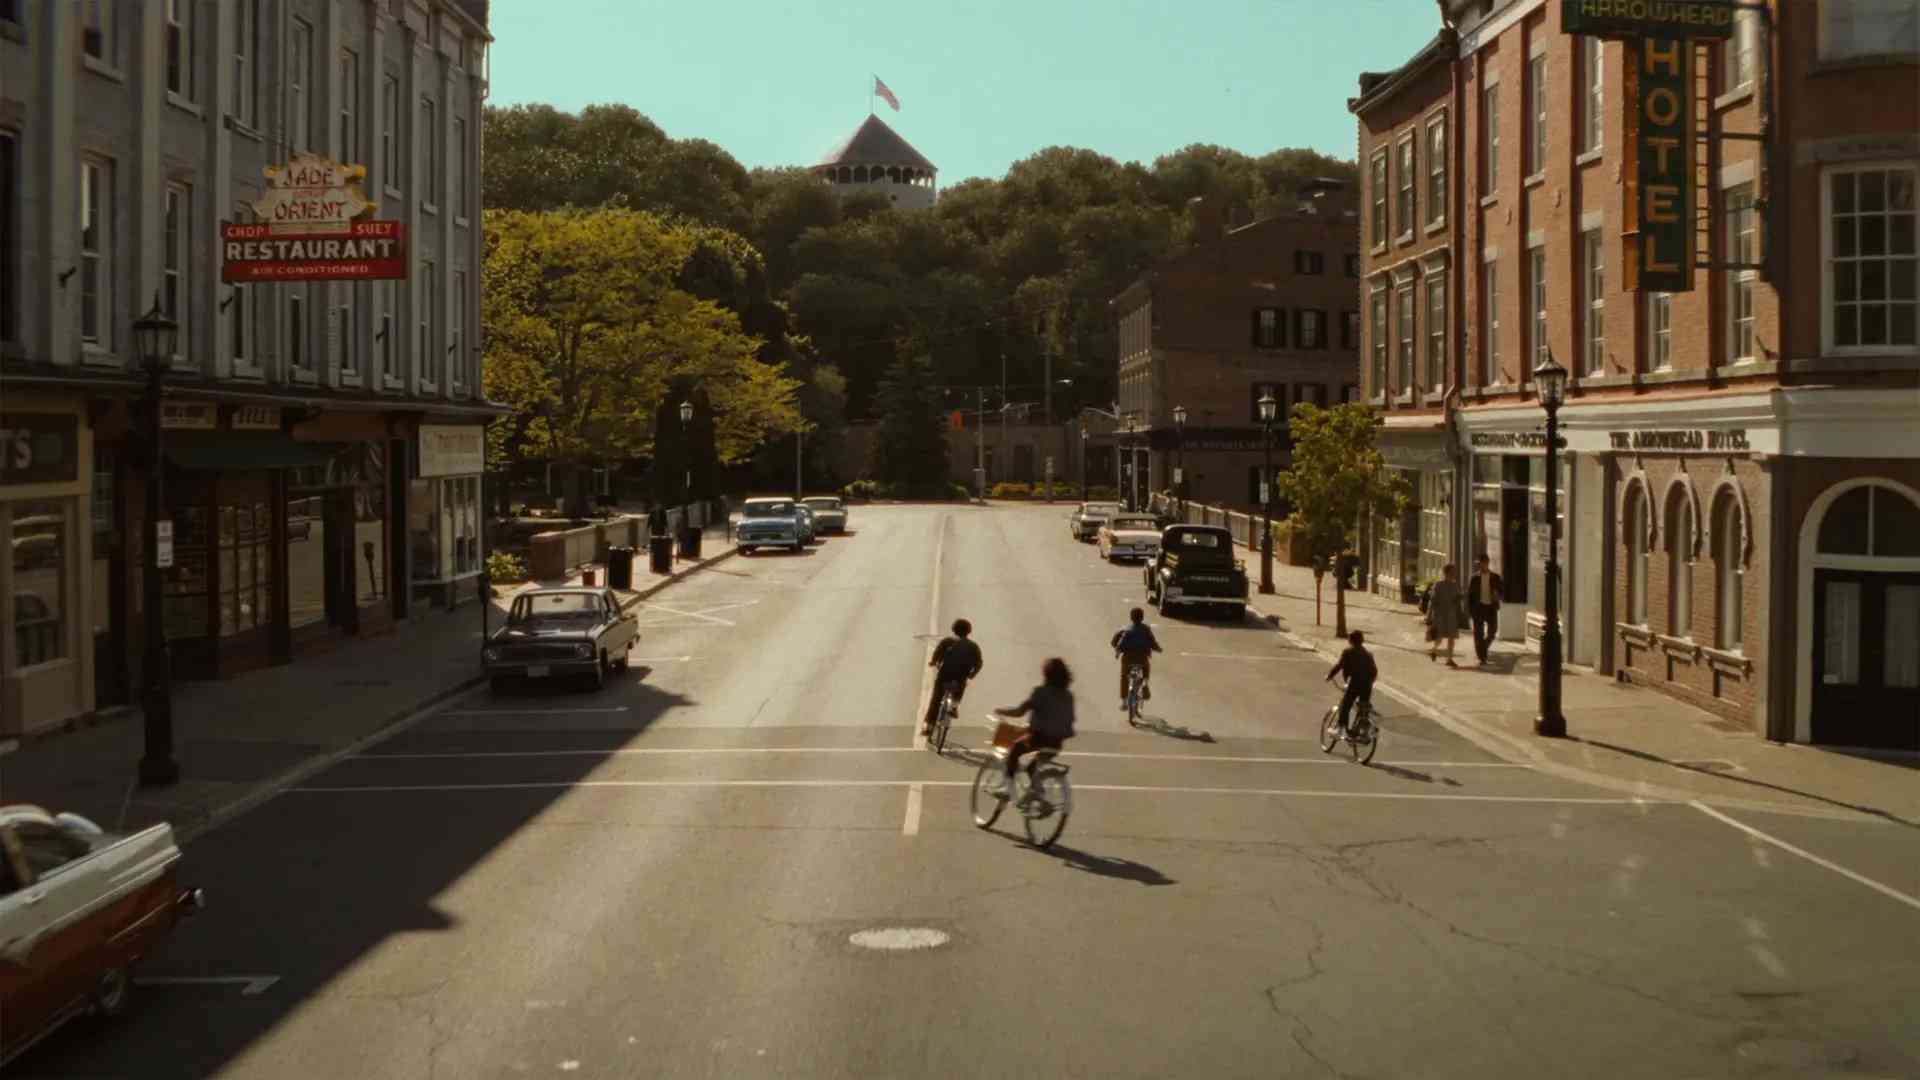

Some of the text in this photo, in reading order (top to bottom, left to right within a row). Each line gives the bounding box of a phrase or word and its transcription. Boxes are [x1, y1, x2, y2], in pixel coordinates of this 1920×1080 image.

[1581, 0, 1730, 26] ARROWHEAD
[1646, 38, 1680, 272] HOTEL
[284, 166, 335, 186] JADE
[274, 201, 348, 220] ORIENT
[226, 226, 265, 238] CHOP
[226, 239, 394, 260] RESTAURANT
[277, 264, 369, 275] CONDITIONED
